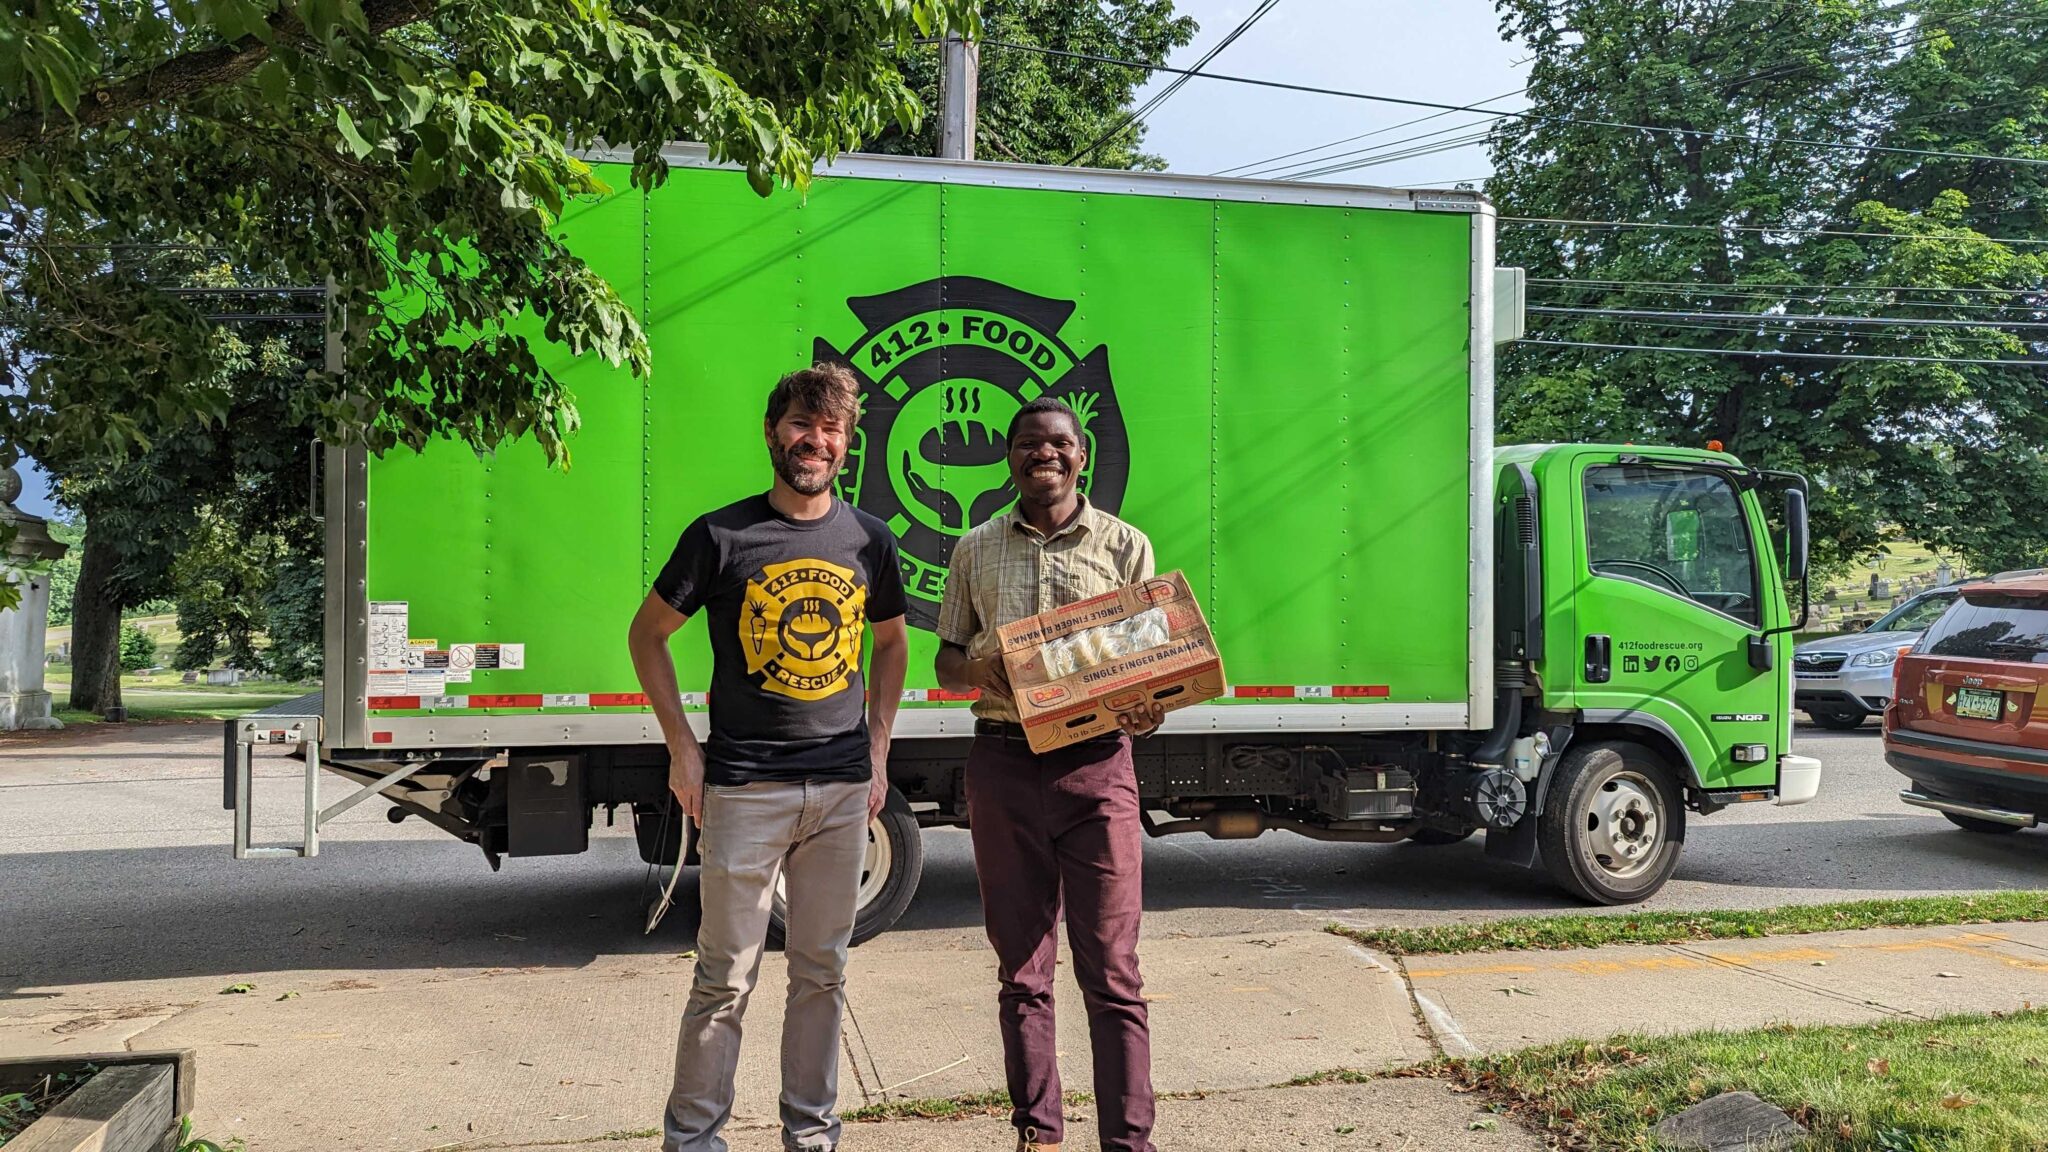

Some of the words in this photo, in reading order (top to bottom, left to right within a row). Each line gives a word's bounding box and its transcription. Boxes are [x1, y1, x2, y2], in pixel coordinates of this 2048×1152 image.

[870, 321, 933, 369] 412
[962, 315, 1056, 371] FOOD
[771, 570, 800, 593] 412
[808, 569, 850, 596] FOOD
[1091, 604, 1124, 618] SINGLE
[1055, 615, 1089, 631] FINGER
[1007, 627, 1053, 646] BANANAS
[1618, 641, 1703, 651] 412foodrescue.org
[1083, 666, 1118, 683] SINGLE
[1119, 655, 1154, 672] FINGER
[1156, 639, 1205, 661] BANANAS
[776, 668, 839, 689] RESCUE
[1962, 675, 1983, 688] Jeep
[1033, 687, 1064, 701] Dole
